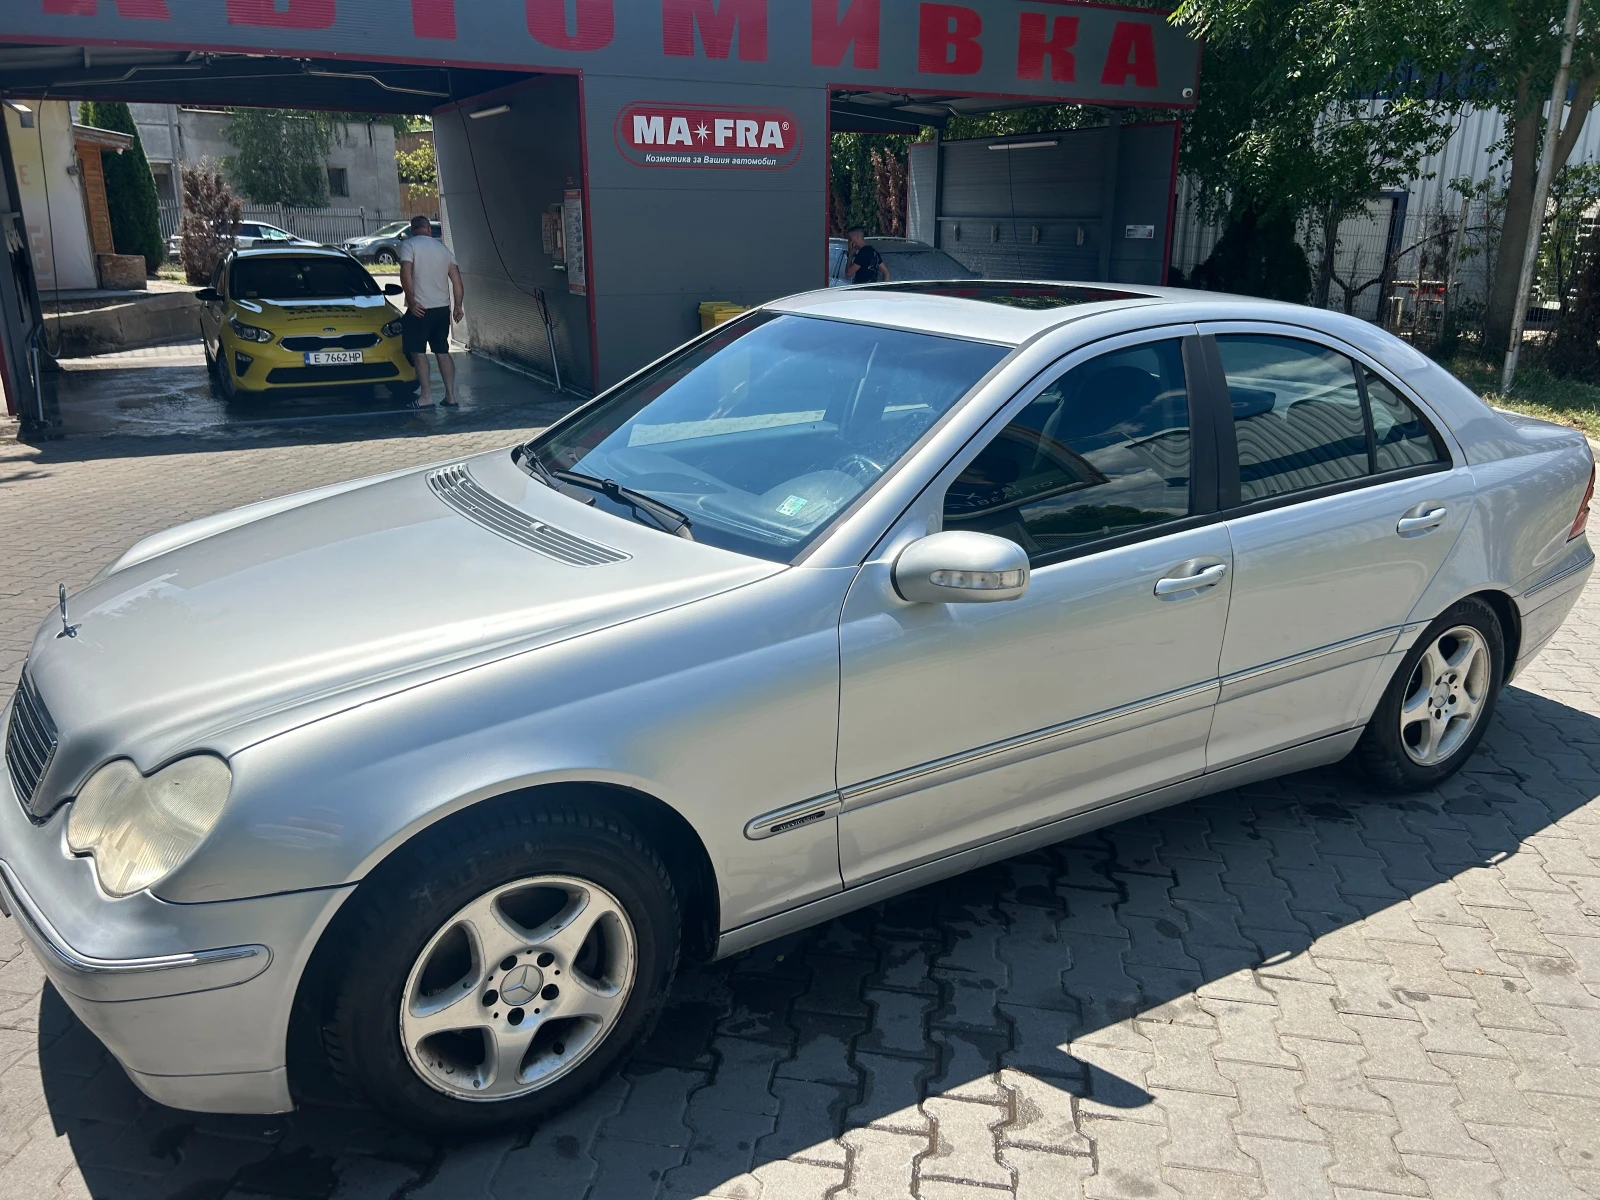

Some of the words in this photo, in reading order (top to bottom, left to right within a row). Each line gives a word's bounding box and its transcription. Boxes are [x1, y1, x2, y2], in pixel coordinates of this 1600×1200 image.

[41, 0, 1159, 88] ОМИВКА
[645, 153, 691, 163] Козметика
[692, 156, 702, 164] за
[703, 155, 730, 164] Вашия
[731, 157, 776, 166] автомобил
[314, 354, 321, 363] E
[325, 353, 348, 363] 7662
[348, 352, 361, 362] HP
